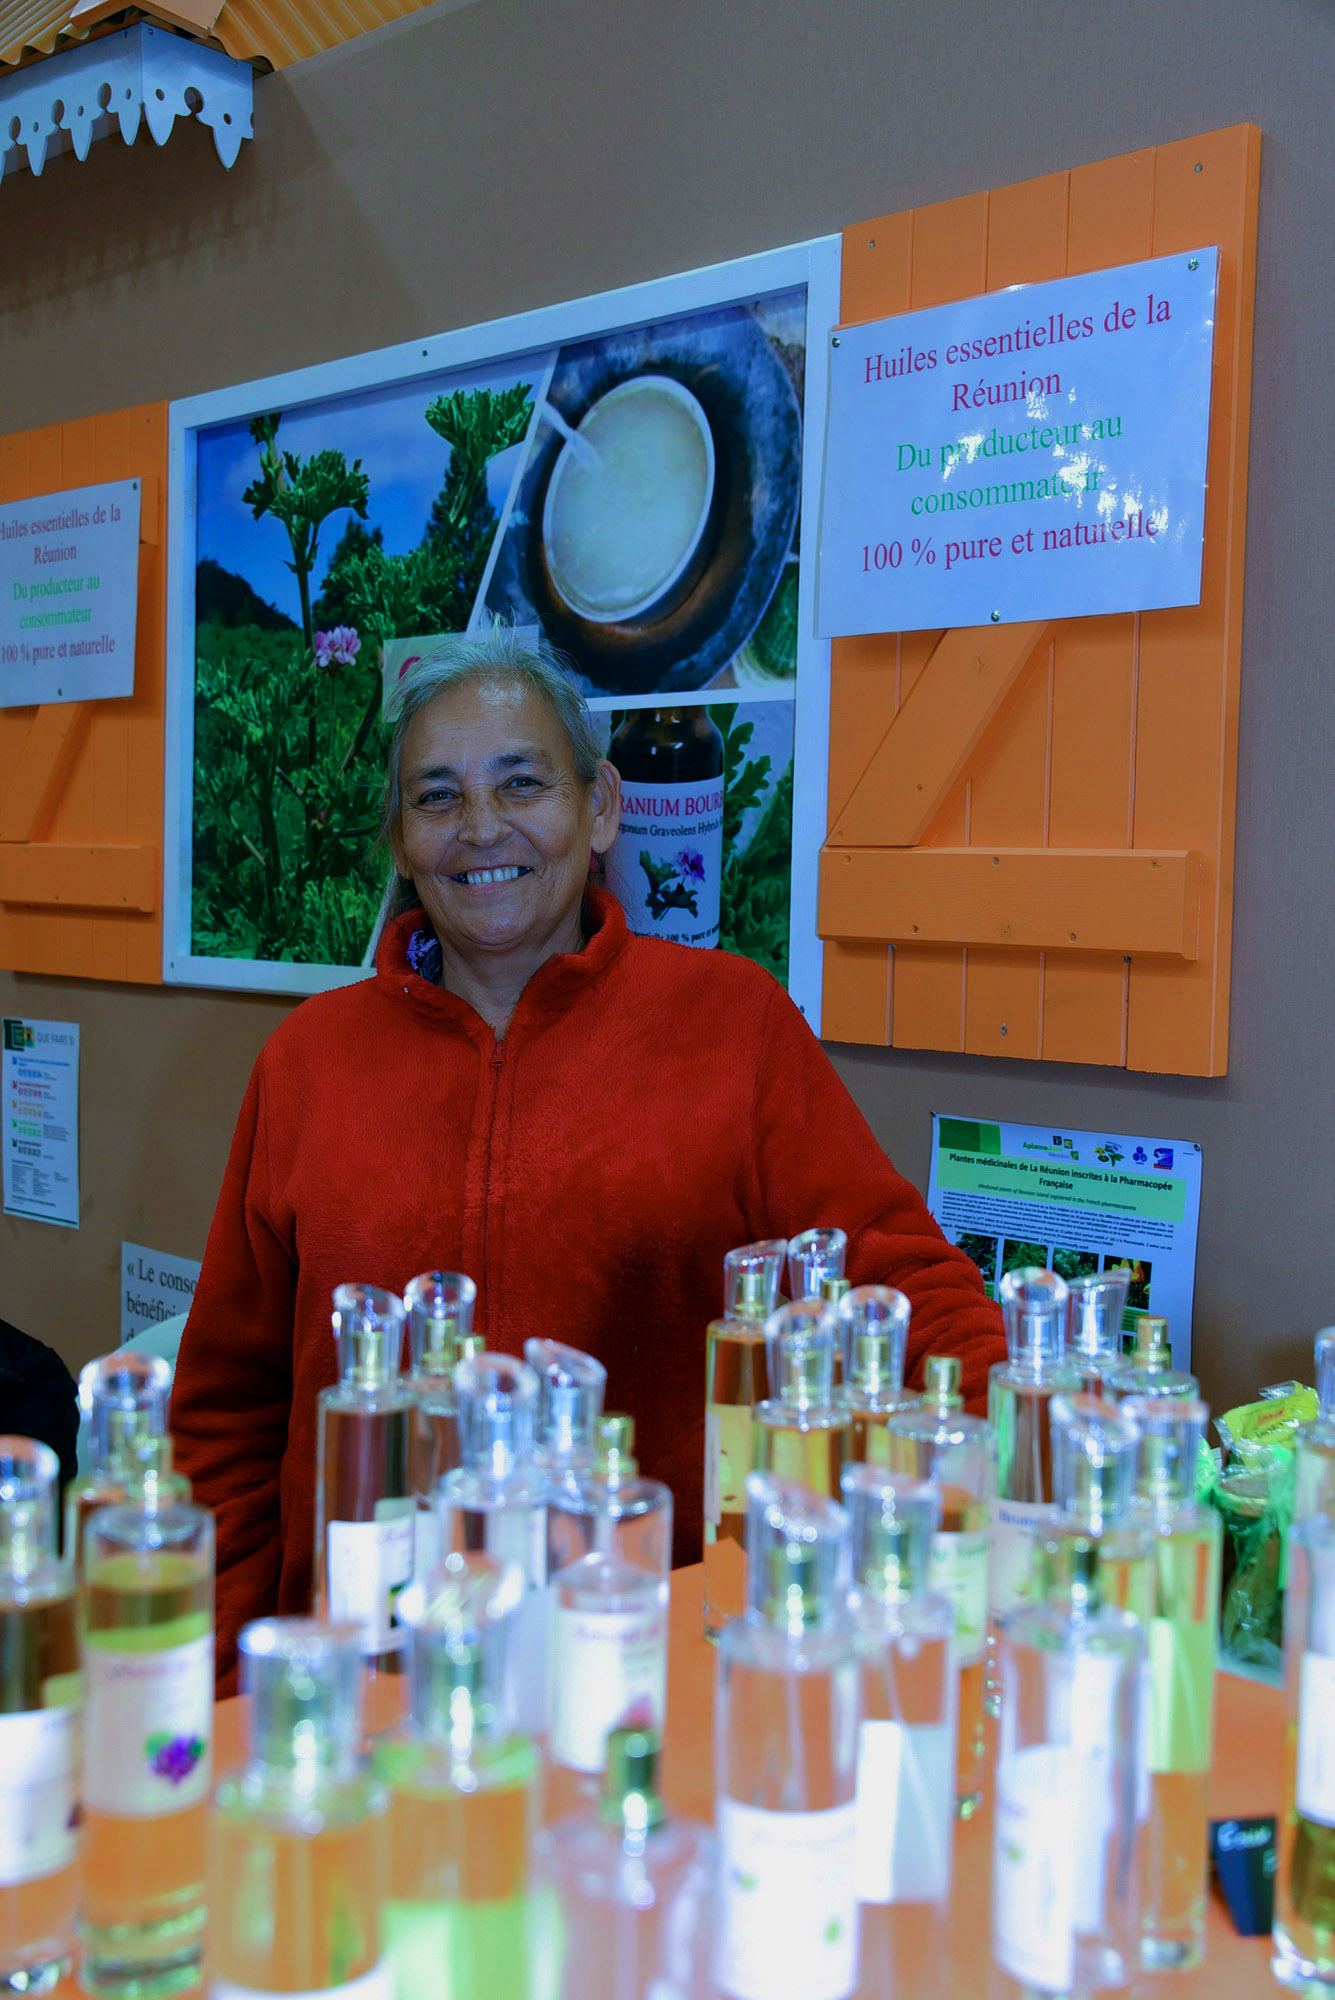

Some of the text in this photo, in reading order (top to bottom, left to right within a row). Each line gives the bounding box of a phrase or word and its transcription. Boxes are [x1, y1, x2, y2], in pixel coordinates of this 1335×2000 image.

[864, 294, 1172, 384] Huiles essentielles de la
[951, 370, 1062, 412] Réunion
[897, 443, 931, 472] Du
[1090, 416, 1123, 441] au
[31, 509, 90, 535] essentielles
[92, 505, 107, 525] de
[110, 503, 121, 523] la
[33, 542, 77, 565] Réunion
[862, 509, 1161, 572] 100 % pure et naturelle
[13, 575, 101, 603] Du producteur au
[20, 607, 93, 630] consommateur
[1, 644, 19, 665] 100
[33, 645, 55, 666] pure
[58, 642, 67, 658] et
[70, 634, 116, 657] naturelle
[650, 824, 697, 837] Graveolens
[949, 1152, 1173, 1191] Plantes médicinales de La Réunion inscrites à la Pharmacopée
[1039, 1178, 1074, 1190] Française
[138, 1258, 155, 1283] Le
